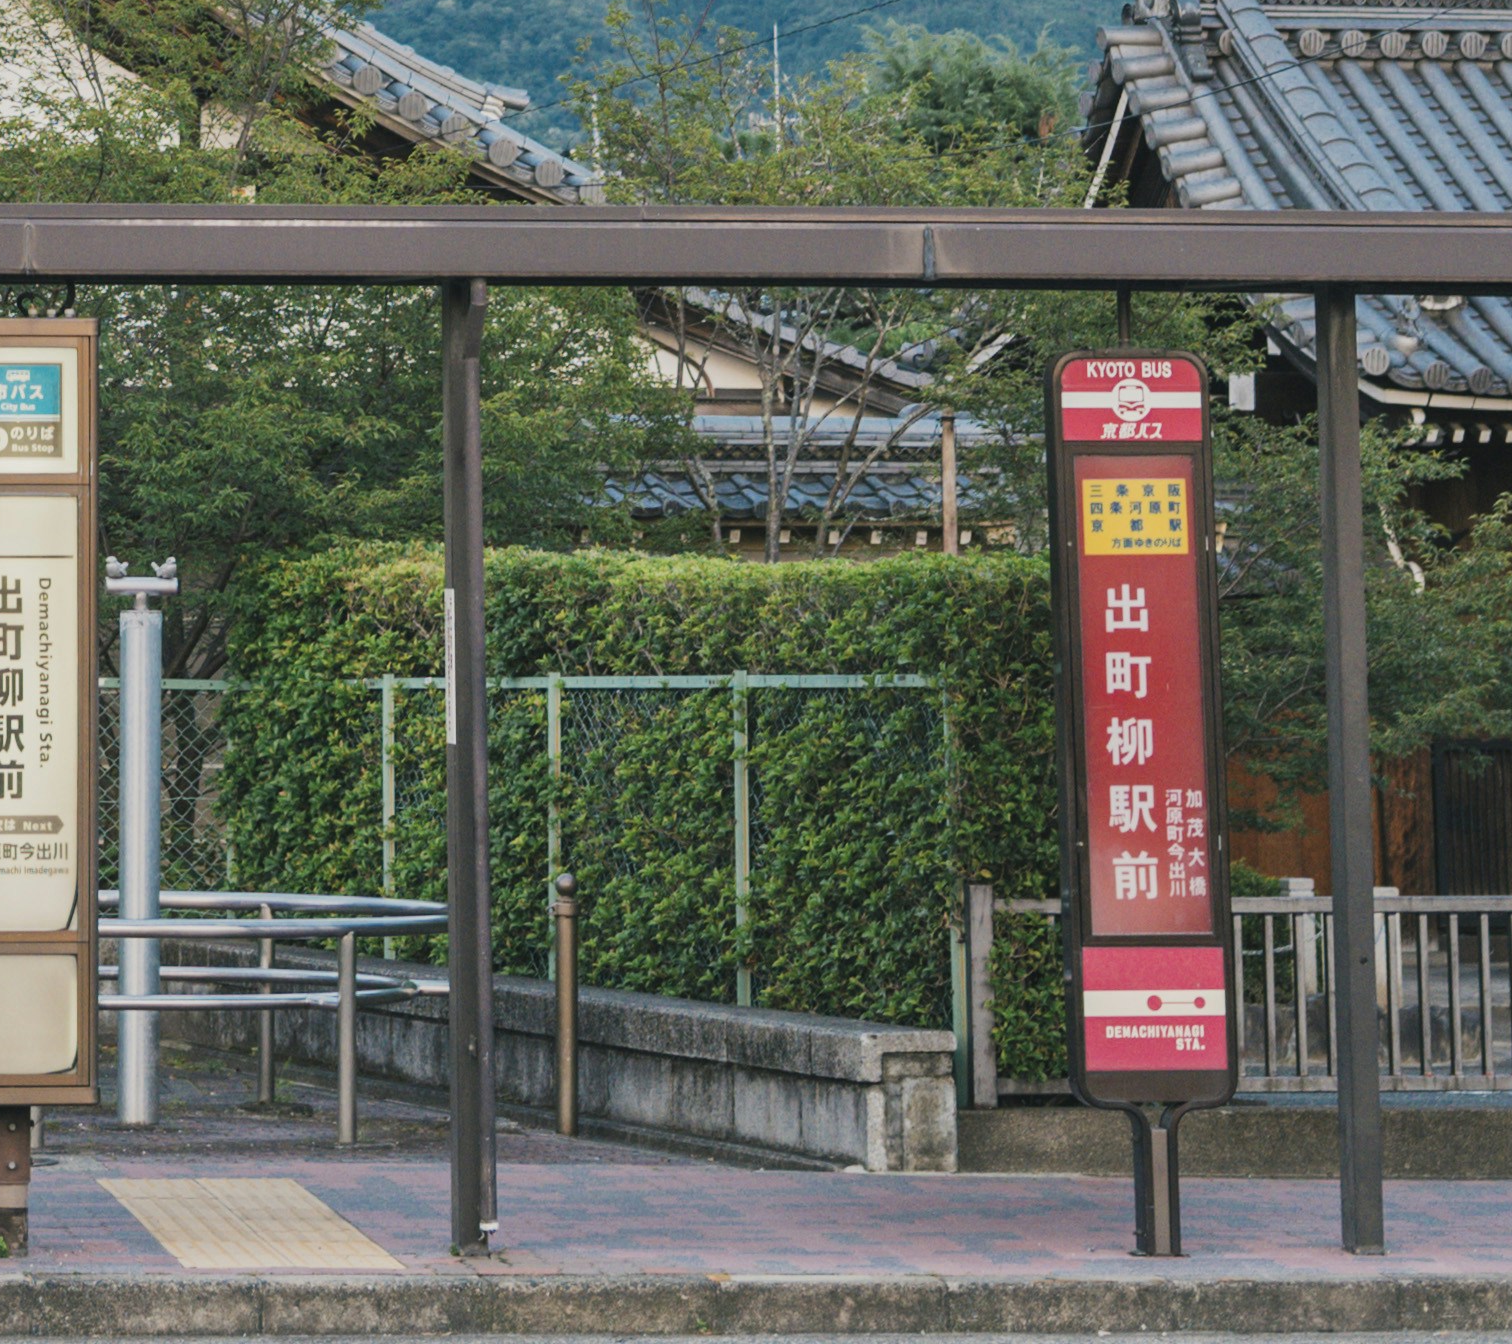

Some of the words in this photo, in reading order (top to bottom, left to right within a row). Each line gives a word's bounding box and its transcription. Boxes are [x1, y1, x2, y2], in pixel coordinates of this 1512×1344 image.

[1087, 362, 1135, 378] KYOTO
[1142, 362, 1172, 378] BUS
[0, 403, 17, 412] City
[20, 403, 35, 411] Bus
[10, 426, 54, 440] のりば
[1100, 423, 1162, 439] 京都バス
[11, 444, 28, 452] Bus
[32, 444, 54, 453] Stop
[1090, 484, 1180, 497] 三条京阪
[1090, 501, 1181, 515] 四条河原町
[1092, 519, 1182, 532] 京都駅
[1112, 538, 1182, 549] 方面ゆきのりば
[36, 578, 52, 724] Demachiyanagi
[1105, 584, 1158, 900] 出町柳駅前
[39, 733, 52, 768] Sta.
[23, 819, 53, 831] Next
[1165, 789, 1186, 897] 河原町今出川
[1186, 789, 1207, 897] 加茂大橋
[24, 865, 69, 876] Imadegawa
[1106, 1025, 1205, 1038] DEMACHIYANAGI
[1176, 1038, 1205, 1051] STA.
